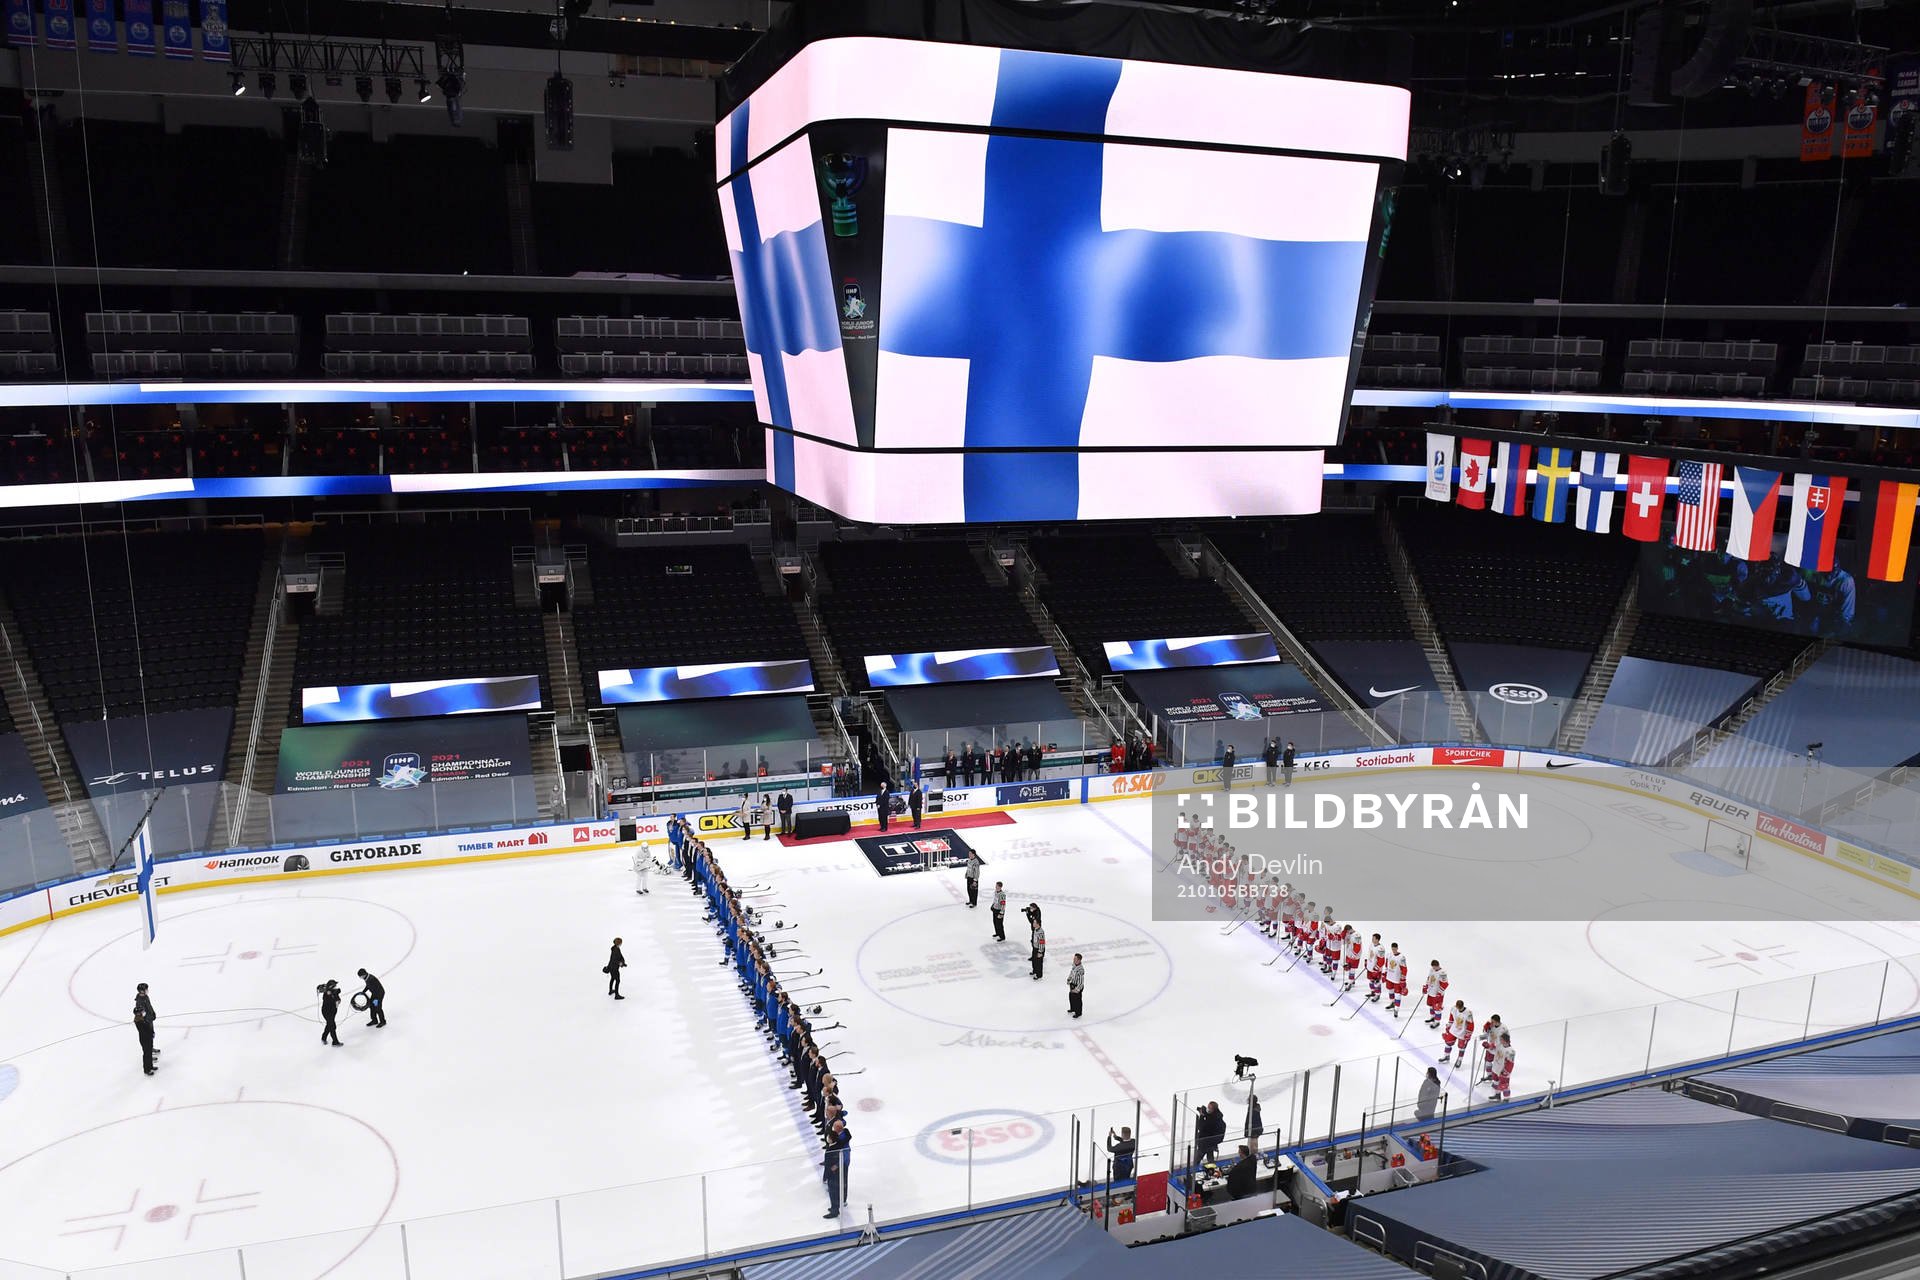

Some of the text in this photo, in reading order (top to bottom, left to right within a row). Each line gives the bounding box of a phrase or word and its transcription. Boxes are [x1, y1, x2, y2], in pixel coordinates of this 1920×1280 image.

[341, 760, 371, 768] 2021
[389, 757, 415, 765] IIHF
[431, 758, 500, 767] CHAMPIONNAT
[1355, 752, 1415, 767] Scotiabank
[431, 761, 511, 772] MONDIAL JUNIOR
[1304, 760, 1330, 772] KEG
[138, 764, 215, 781] TELUS
[295, 772, 371, 781] CHAMPIONSHIP
[296, 768, 371, 778] WORLD JUNIOR
[1193, 770, 1220, 785] OK
[1128, 773, 1166, 792] SKIP
[1640, 774, 1666, 785] TELUS
[1033, 786, 1047, 794] BFL
[1630, 779, 1663, 793] Optik TV
[699, 814, 734, 831] OK
[1759, 815, 1822, 852] Tim Hortons
[458, 839, 526, 851] TIMBER MART
[330, 844, 422, 862] GATORADE
[69, 876, 170, 906] CHEVROET
